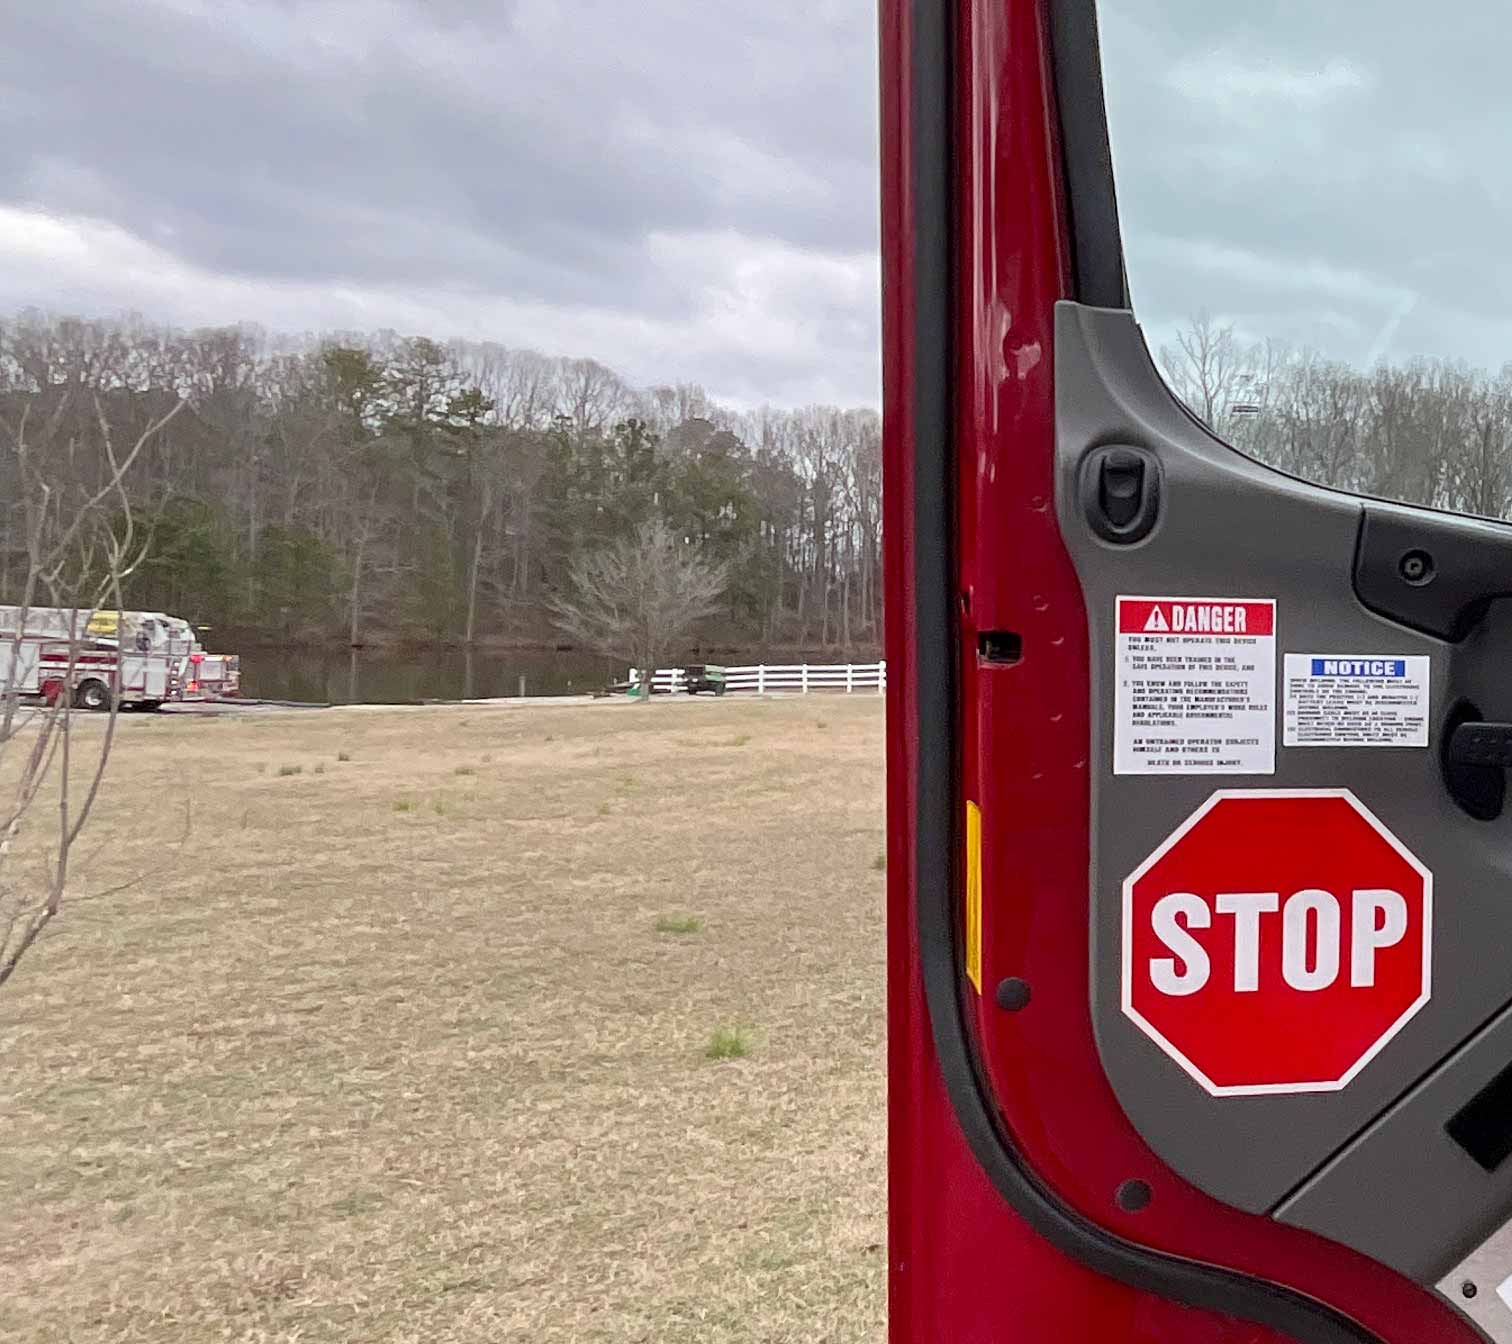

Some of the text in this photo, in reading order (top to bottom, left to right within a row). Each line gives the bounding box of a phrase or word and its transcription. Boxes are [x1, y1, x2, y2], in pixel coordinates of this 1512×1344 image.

[1172, 606, 1247, 633] DANGER
[1324, 661, 1396, 676] NOTICE
[1149, 888, 1408, 996] STOP
